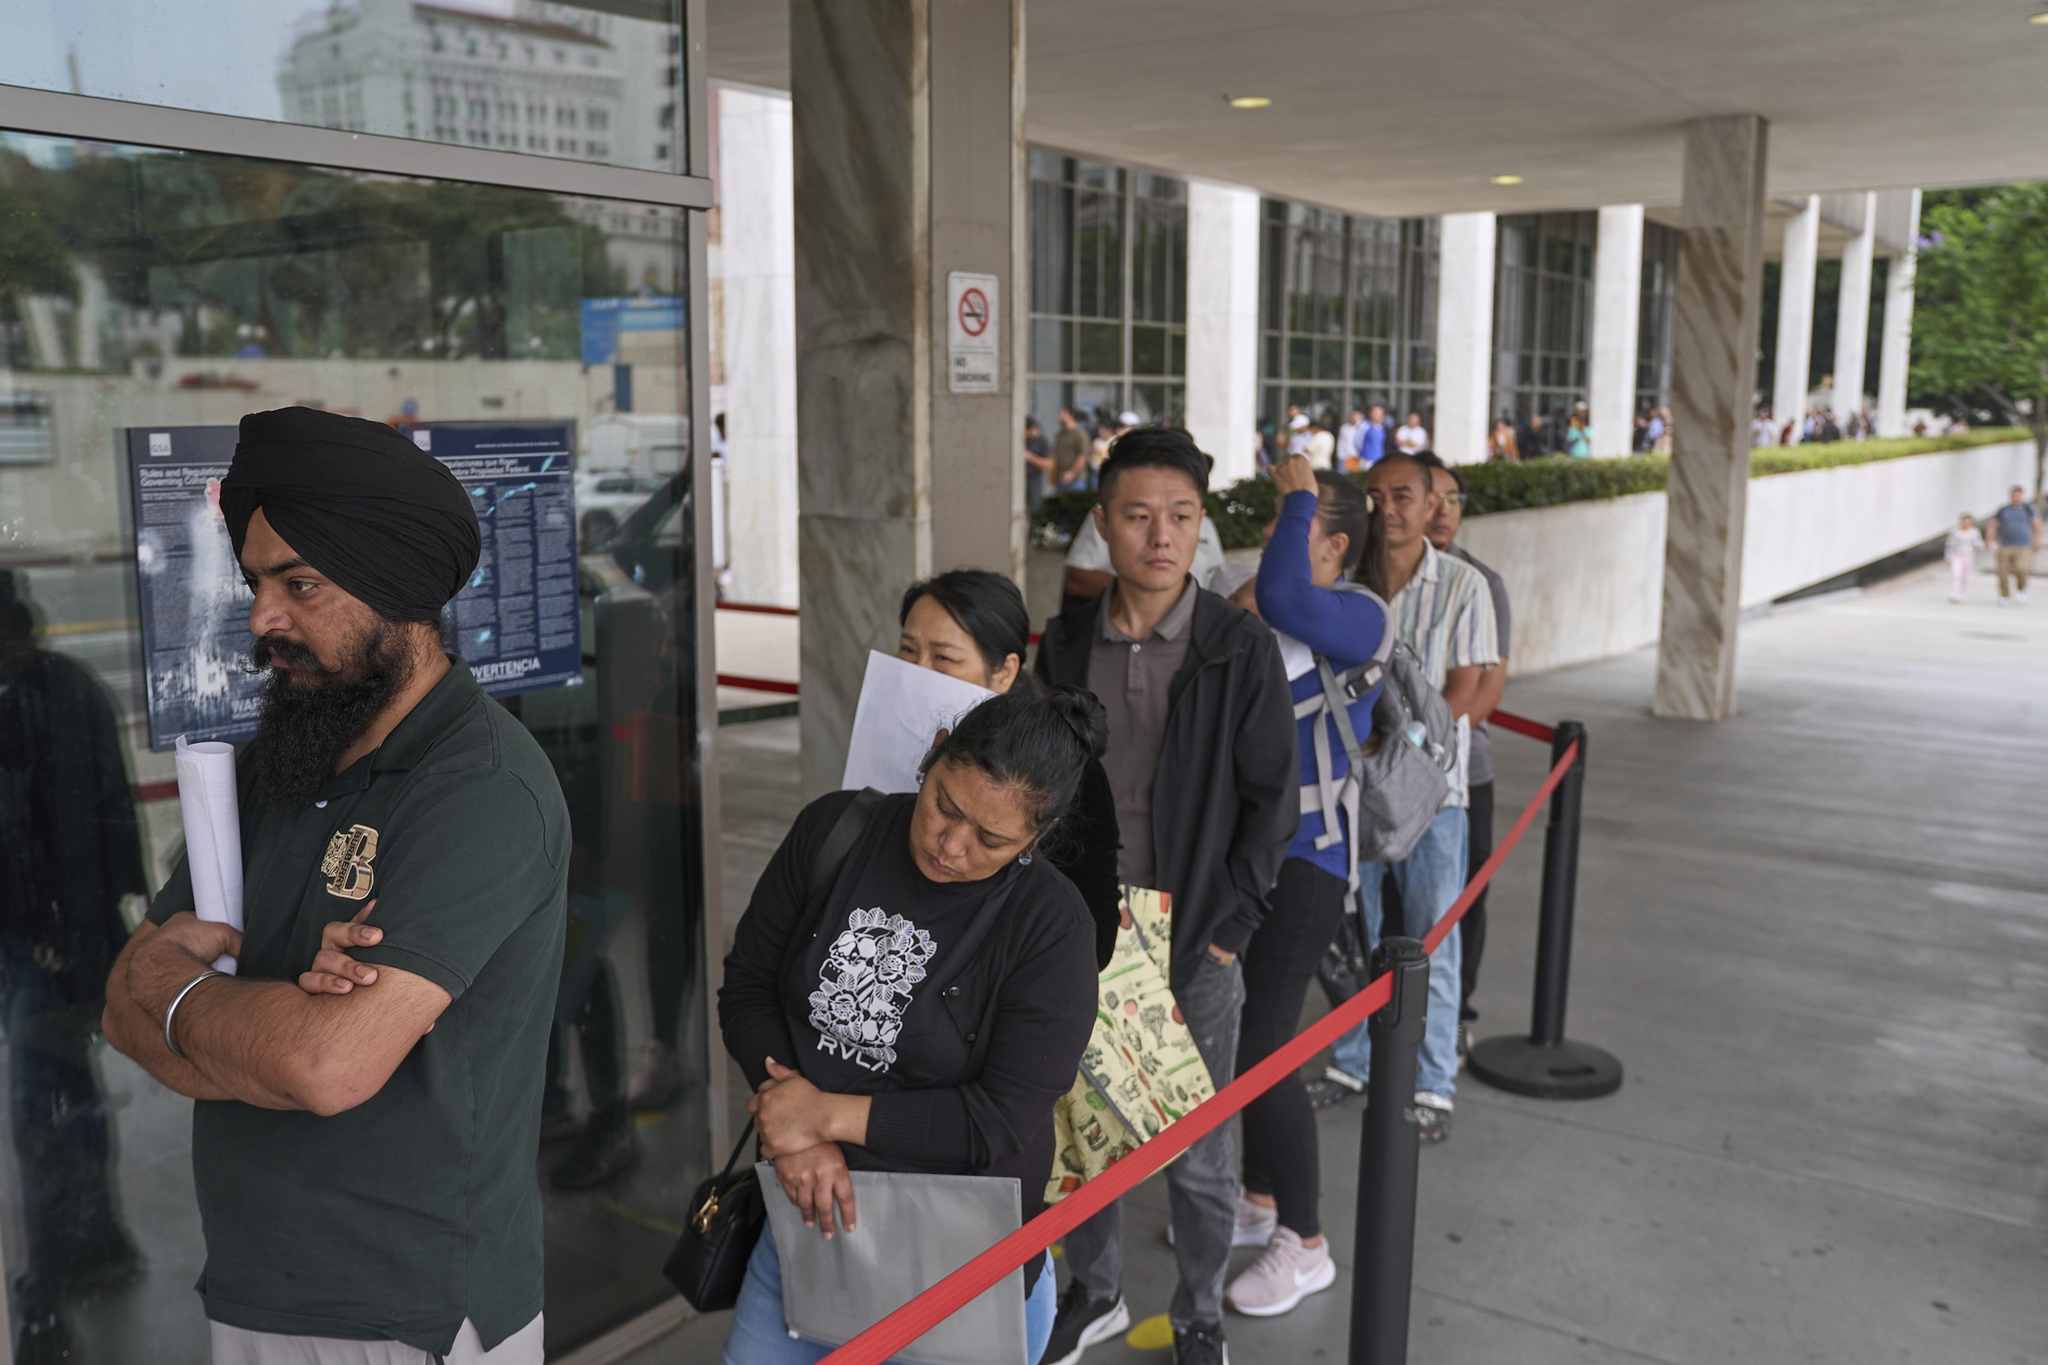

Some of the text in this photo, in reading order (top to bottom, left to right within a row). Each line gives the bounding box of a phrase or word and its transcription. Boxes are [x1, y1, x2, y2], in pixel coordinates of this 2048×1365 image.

[954, 357, 967, 368] NO
[955, 372, 991, 383] SMOKING
[140, 468, 164, 478] Rules
[165, 468, 181, 477] and
[505, 465, 531, 474] Federal
[140, 477, 183, 488] Governing
[334, 830, 362, 890] BURBERRY
